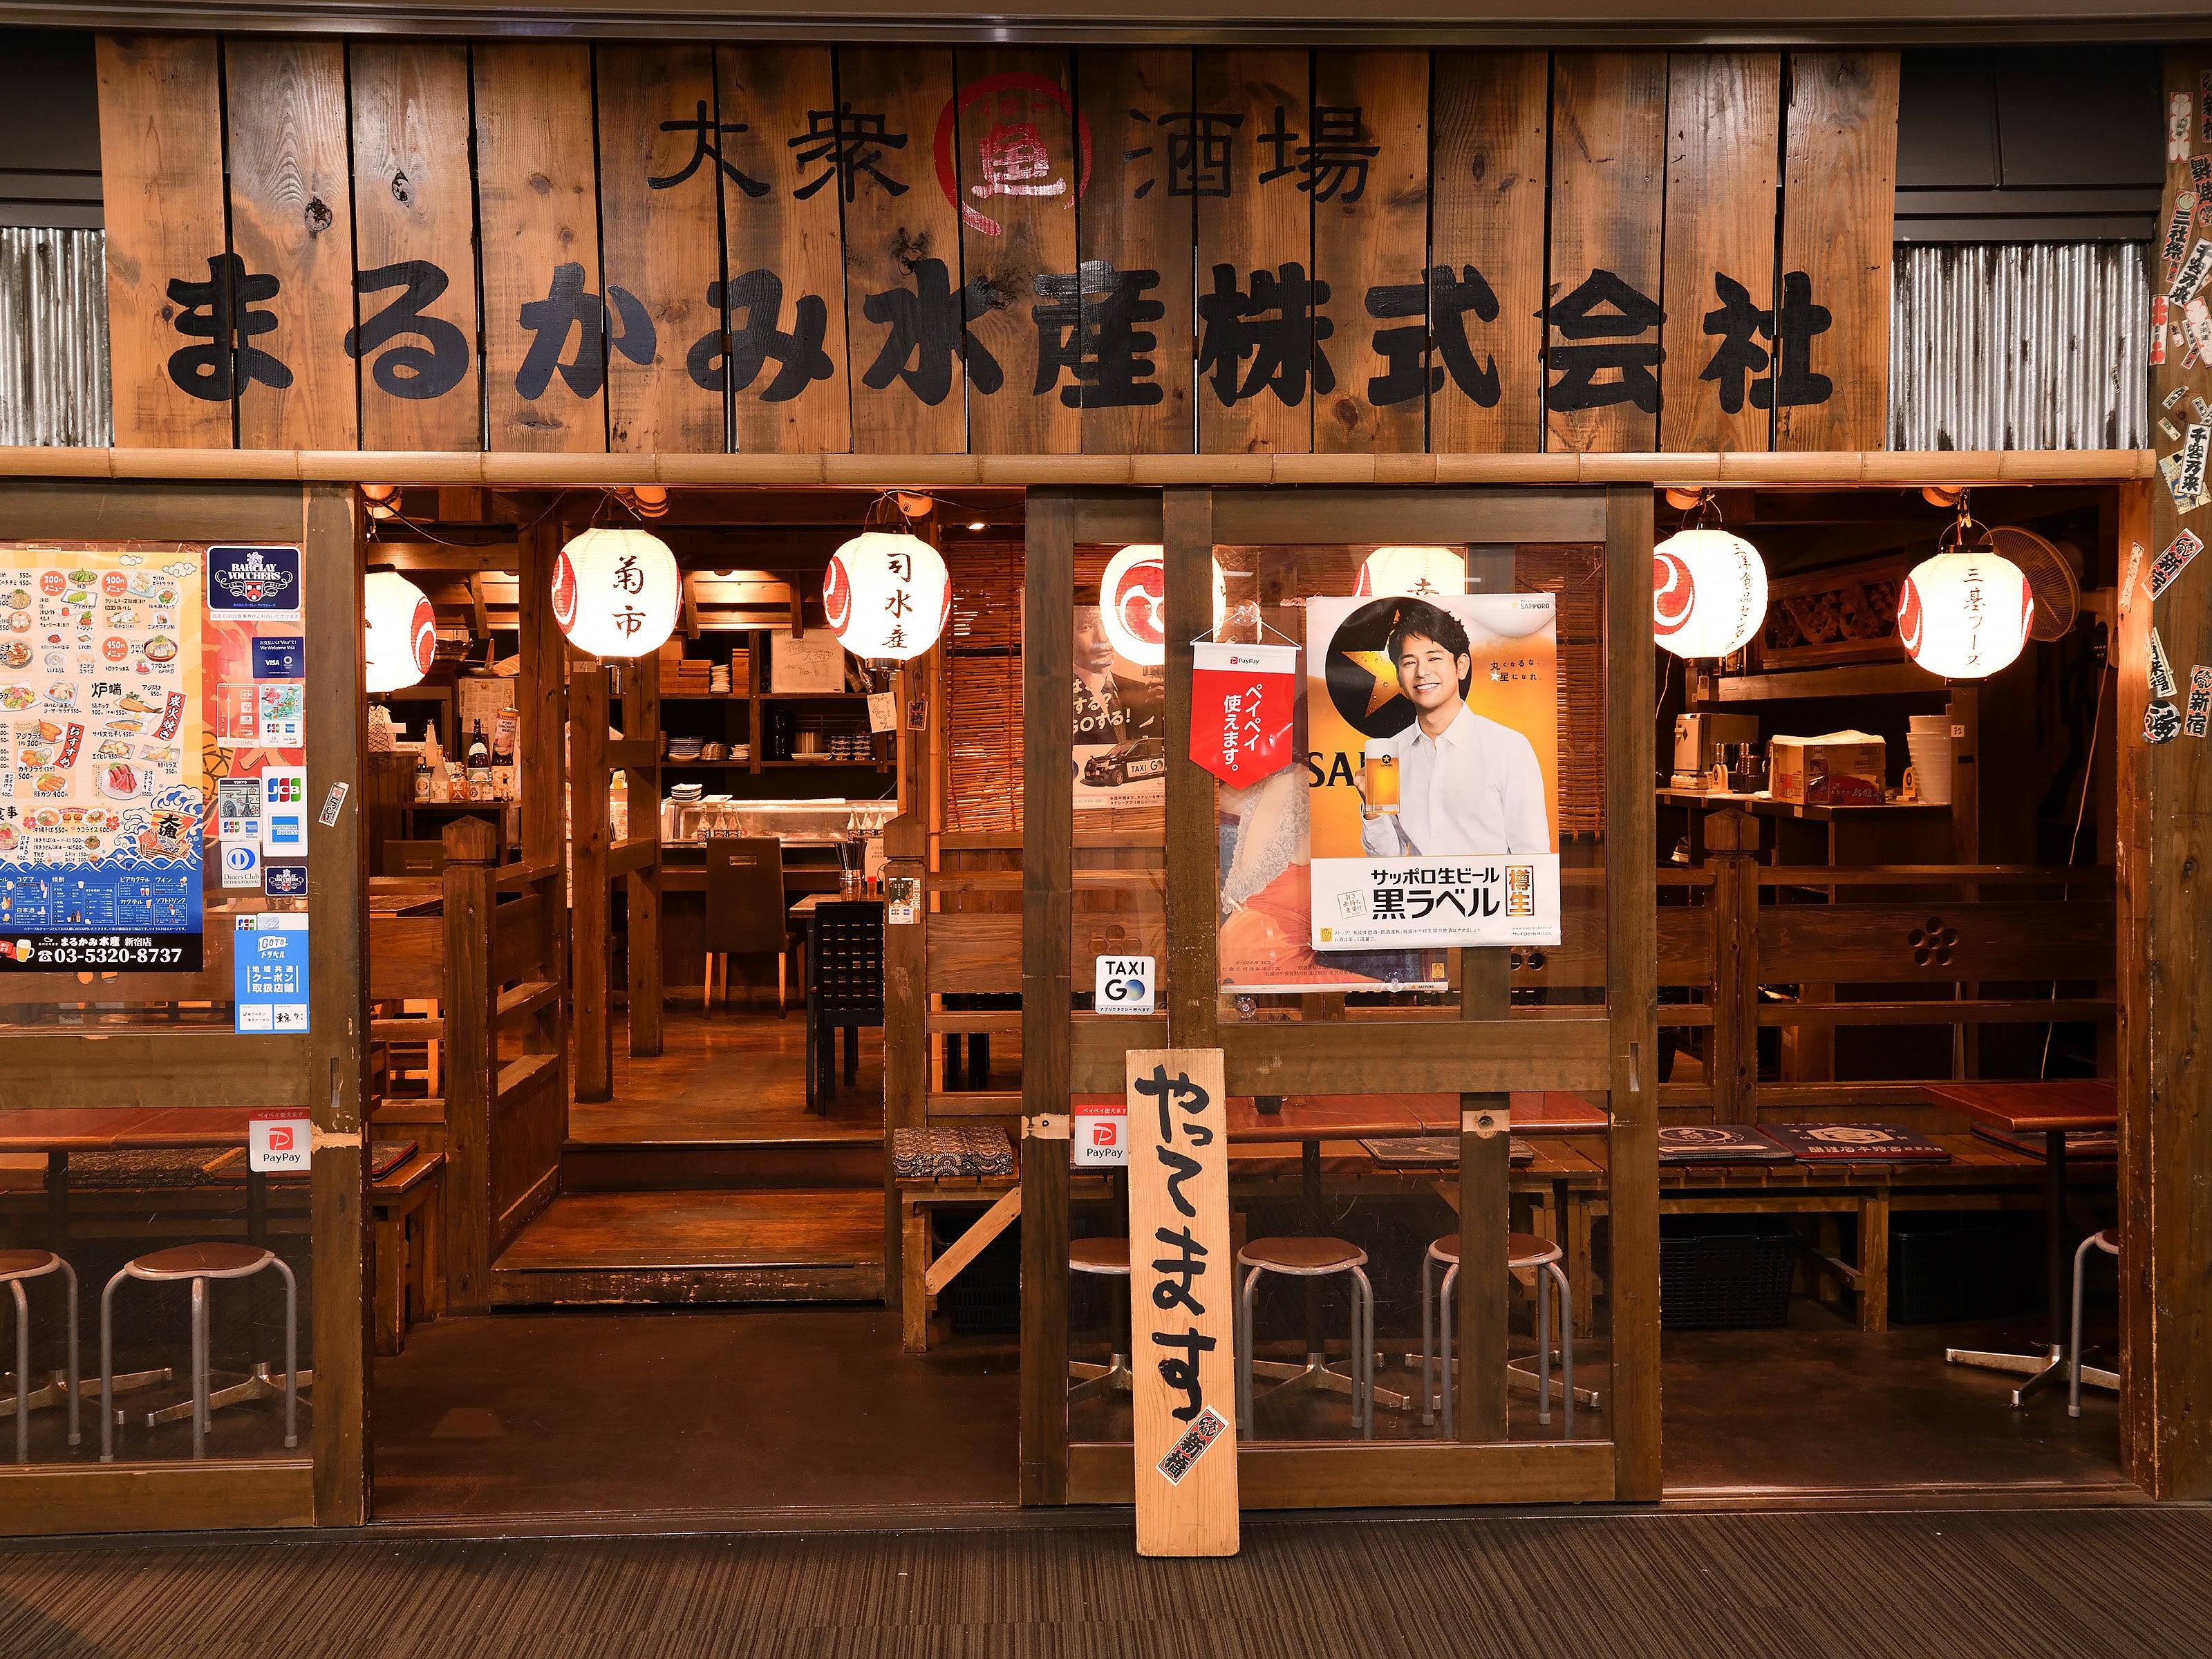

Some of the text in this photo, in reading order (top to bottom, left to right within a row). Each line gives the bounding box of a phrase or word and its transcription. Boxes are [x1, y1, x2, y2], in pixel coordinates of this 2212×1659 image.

[648, 100, 1381, 204] 大衆 酒場
[2164, 210, 2193, 261] 三社祭
[167, 253, 1833, 413] まるかみ水産株式会社
[2182, 427, 2207, 491] 千客万来
[228, 572, 282, 581] VOUCHERS
[232, 563, 277, 572] BARCLAY
[611, 555, 646, 639] 菊市
[881, 552, 912, 649] 司水産
[1962, 567, 1987, 667] 三基フーズ
[1238, 657, 1259, 665] PayPay
[92, 682, 122, 698] 炉端
[158, 695, 182, 740] 炭火焼き
[1244, 684, 1263, 751] ペイペイ
[2187, 690, 2211, 735] 新宿
[59, 726, 81, 768] おすすめ
[1222, 695, 1242, 771] 使えます。
[1131, 765, 1147, 773] TAXI
[1309, 751, 1365, 787] SA
[158, 814, 182, 839] 大漁
[1371, 867, 1500, 885] サッポロ生ビール
[1509, 868, 1531, 914] 樽生
[1371, 888, 1500, 920] 黒ラベル
[55, 948, 182, 963] 03-5320-8737
[61, 936, 152, 947] まるかみ水産 新宿店
[252, 973, 294, 982] クーポン
[1105, 962, 1145, 975] TAXI
[252, 984, 294, 993] 取扱店舗
[1105, 979, 1145, 1001] GO
[263, 1153, 301, 1163] PayPay
[1087, 1147, 1123, 1159] PayPay
[1134, 1064, 1217, 1425] やってます
